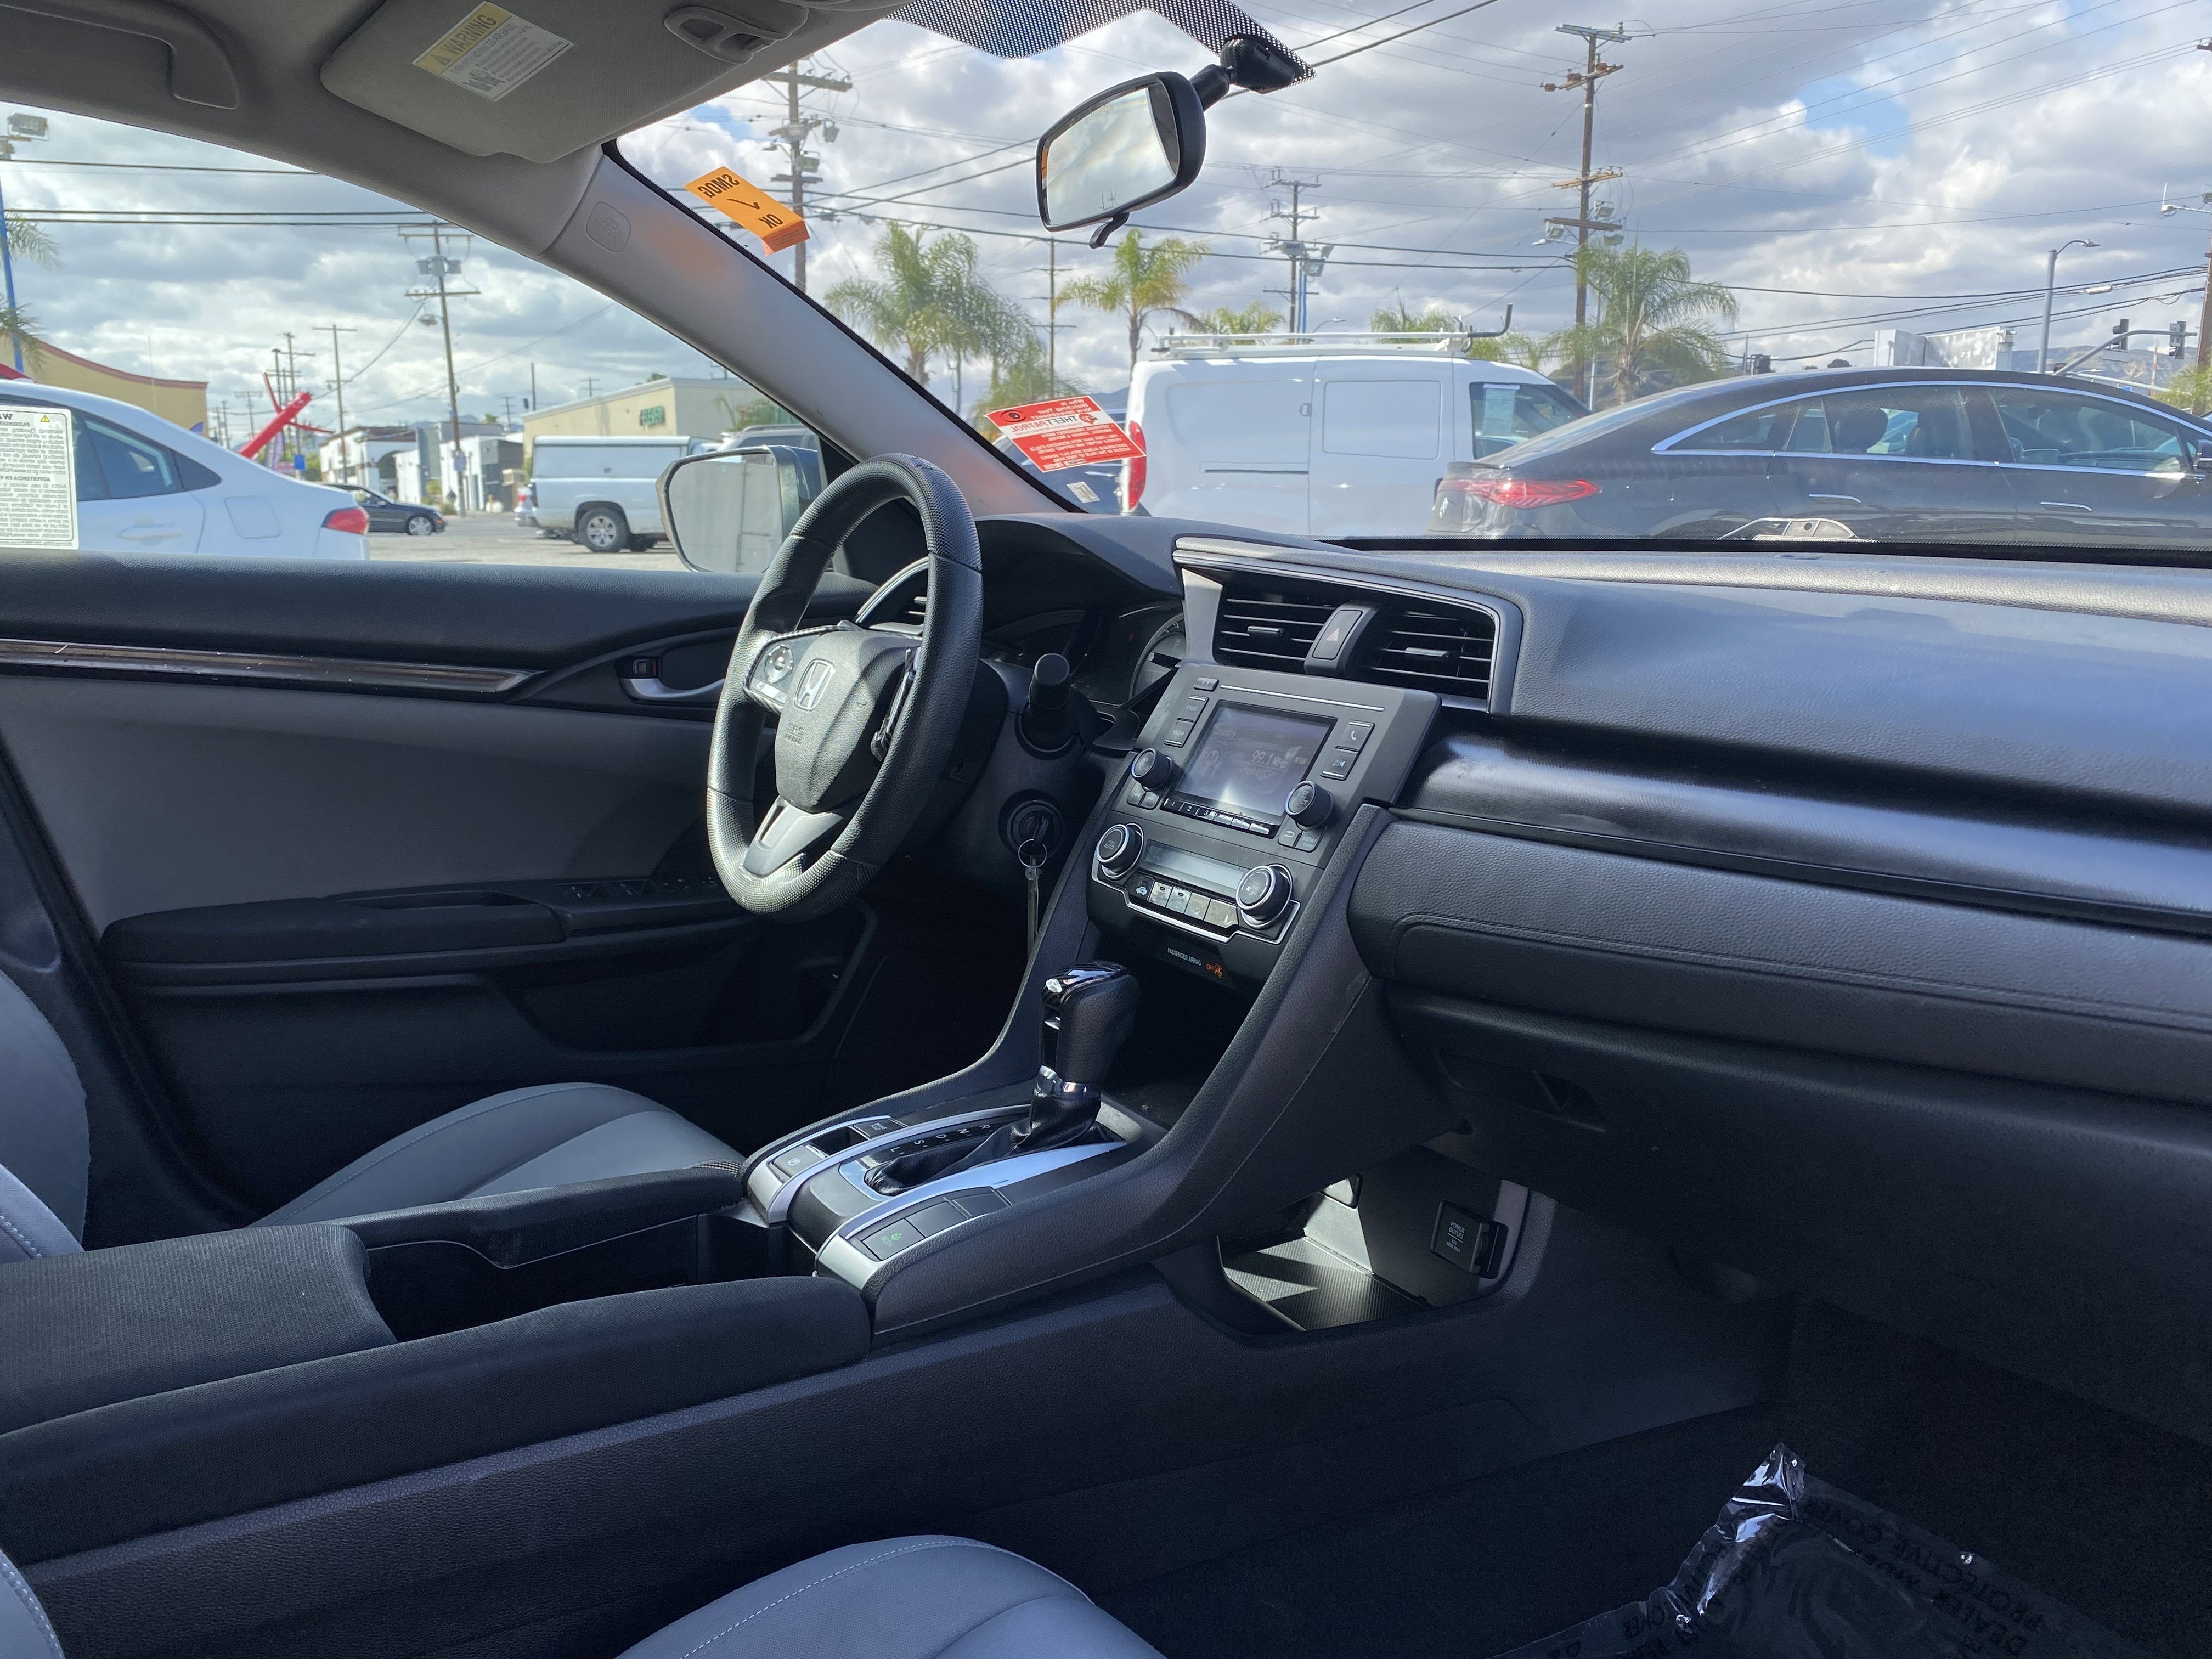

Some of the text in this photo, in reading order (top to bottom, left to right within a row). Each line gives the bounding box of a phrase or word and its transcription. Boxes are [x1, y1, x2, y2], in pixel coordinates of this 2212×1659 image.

[443, 14, 497, 54] WARNING
[787, 723, 804, 736] SRS
[1213, 726, 1237, 739] Country
[1251, 749, 1273, 766] 99.1
[1271, 756, 1288, 769] MHz
[1167, 947, 1201, 966] PASSENGER AIRBAG
[1449, 1227, 1464, 1239] OUTLET
[1451, 1221, 1465, 1234] POWER
